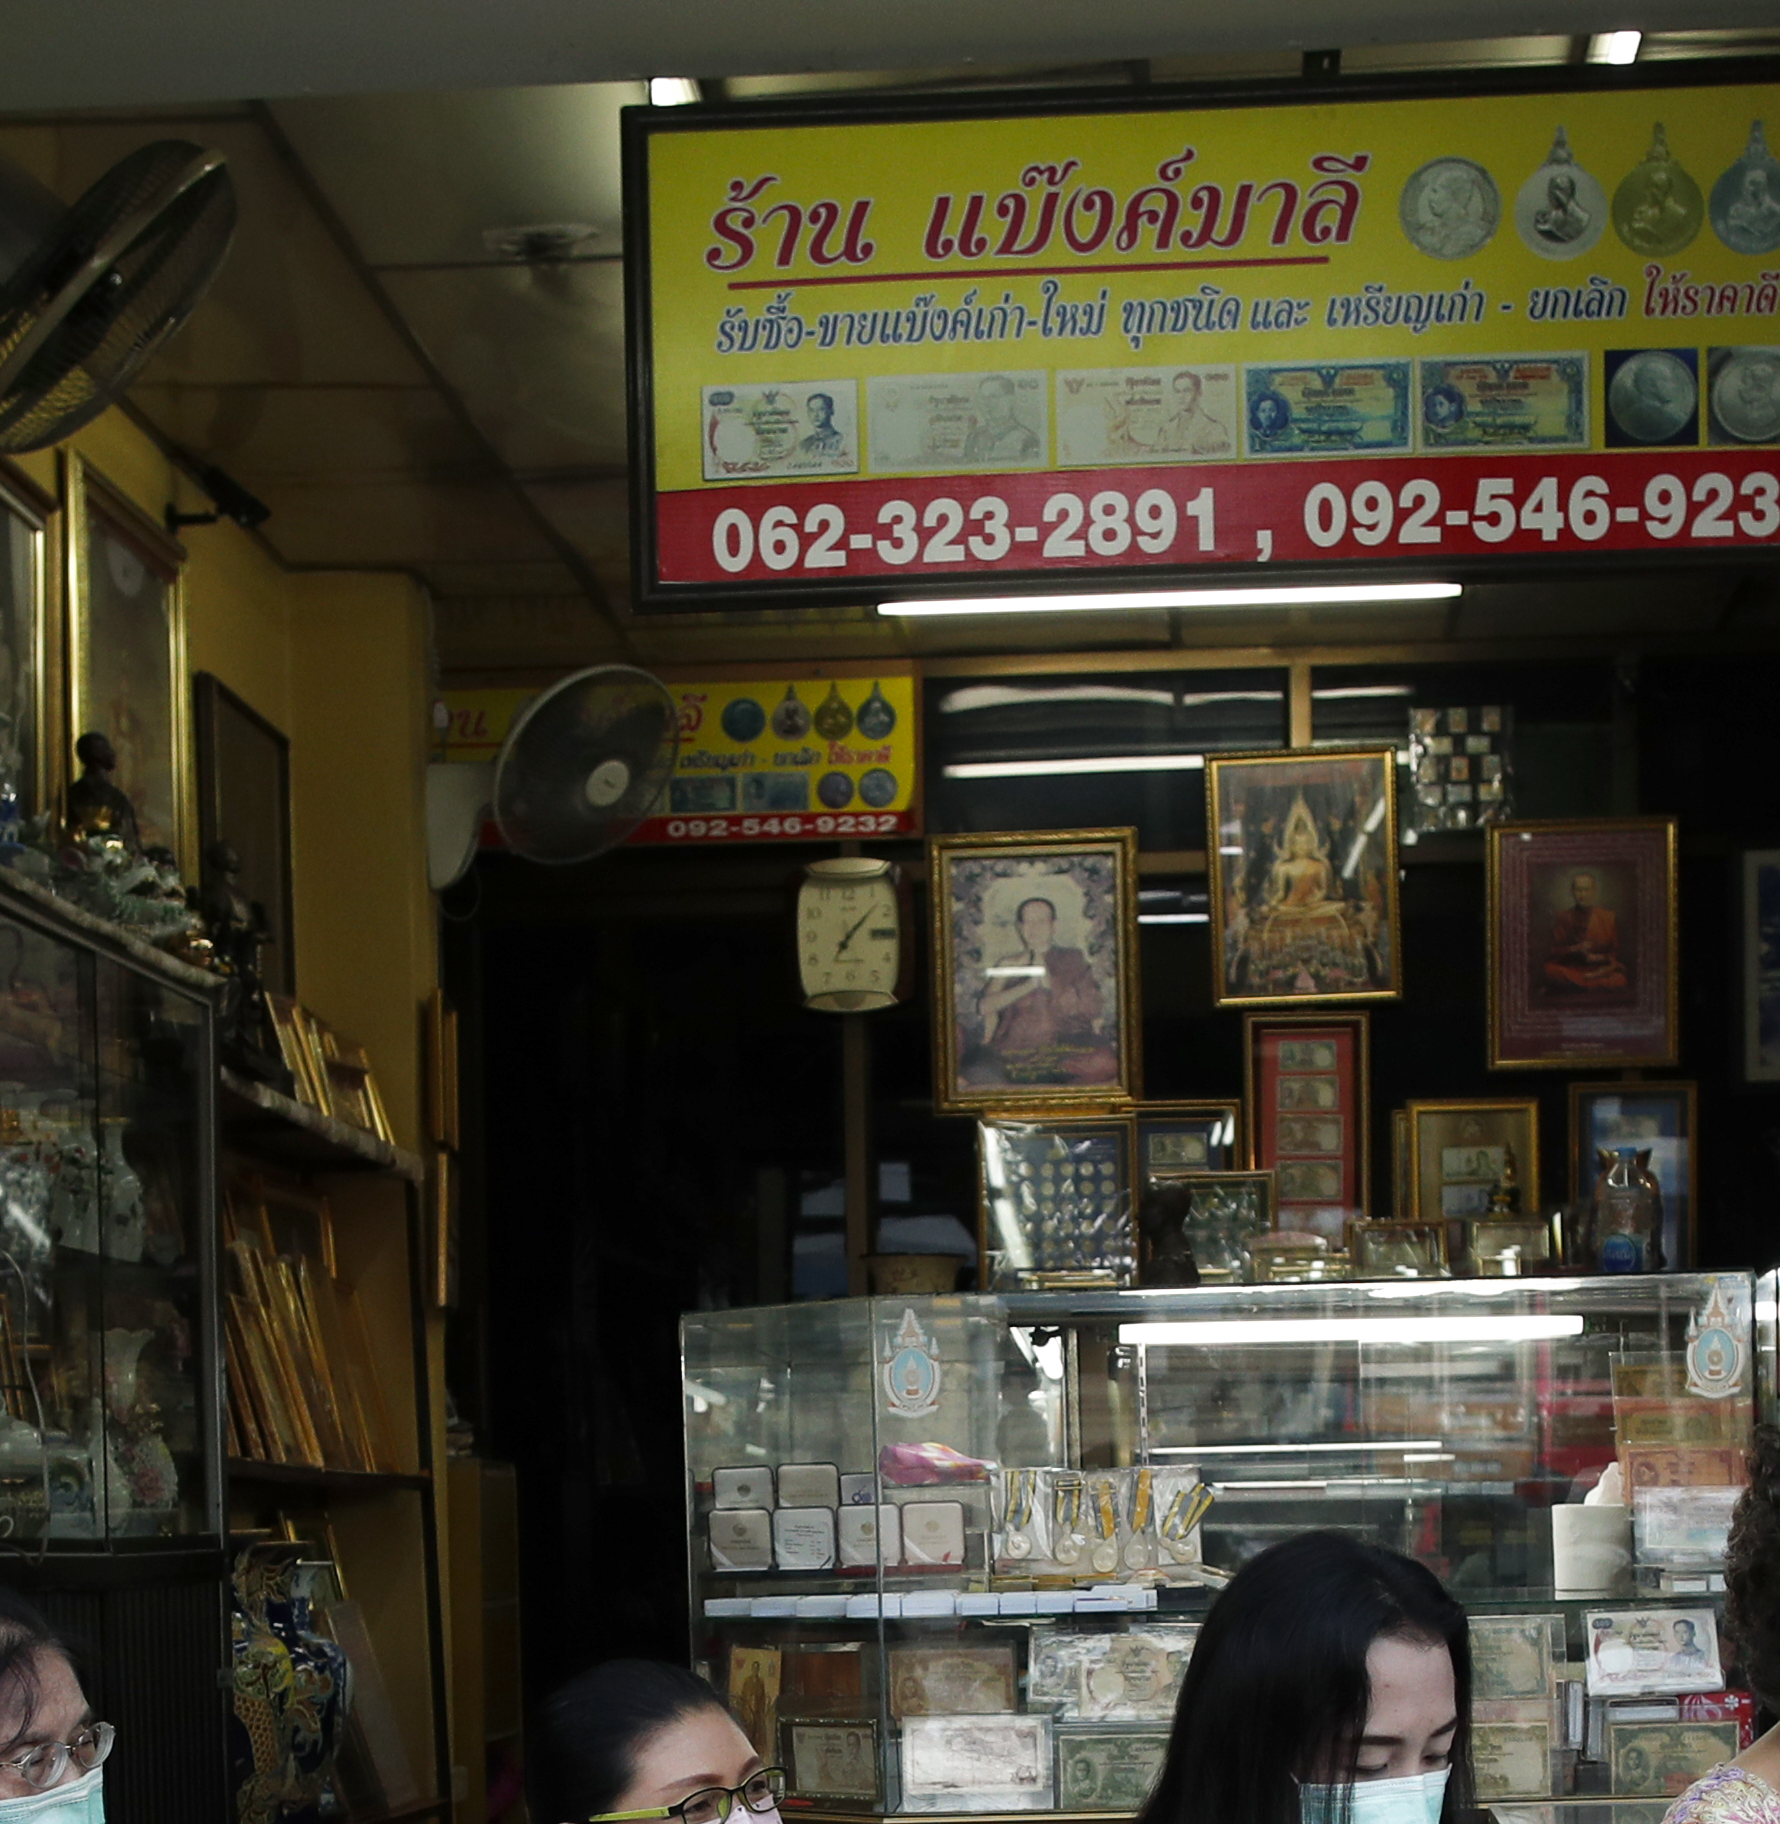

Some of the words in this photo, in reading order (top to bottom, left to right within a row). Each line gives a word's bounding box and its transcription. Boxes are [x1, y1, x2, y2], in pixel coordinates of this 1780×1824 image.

[705, 176, 875, 271] ร้าน
[923, 147, 1371, 261] แบ๊งค์มาลี
[1122, 286, 1241, 351] ทุกชนิด
[1250, 295, 1310, 332] และ
[1325, 280, 1486, 334] เหรียญเก่า
[1527, 281, 1626, 322] ยกเลิก
[712, 487, 1216, 573] 062-323-2891
[666, 814, 898, 839] 092-546-9232
